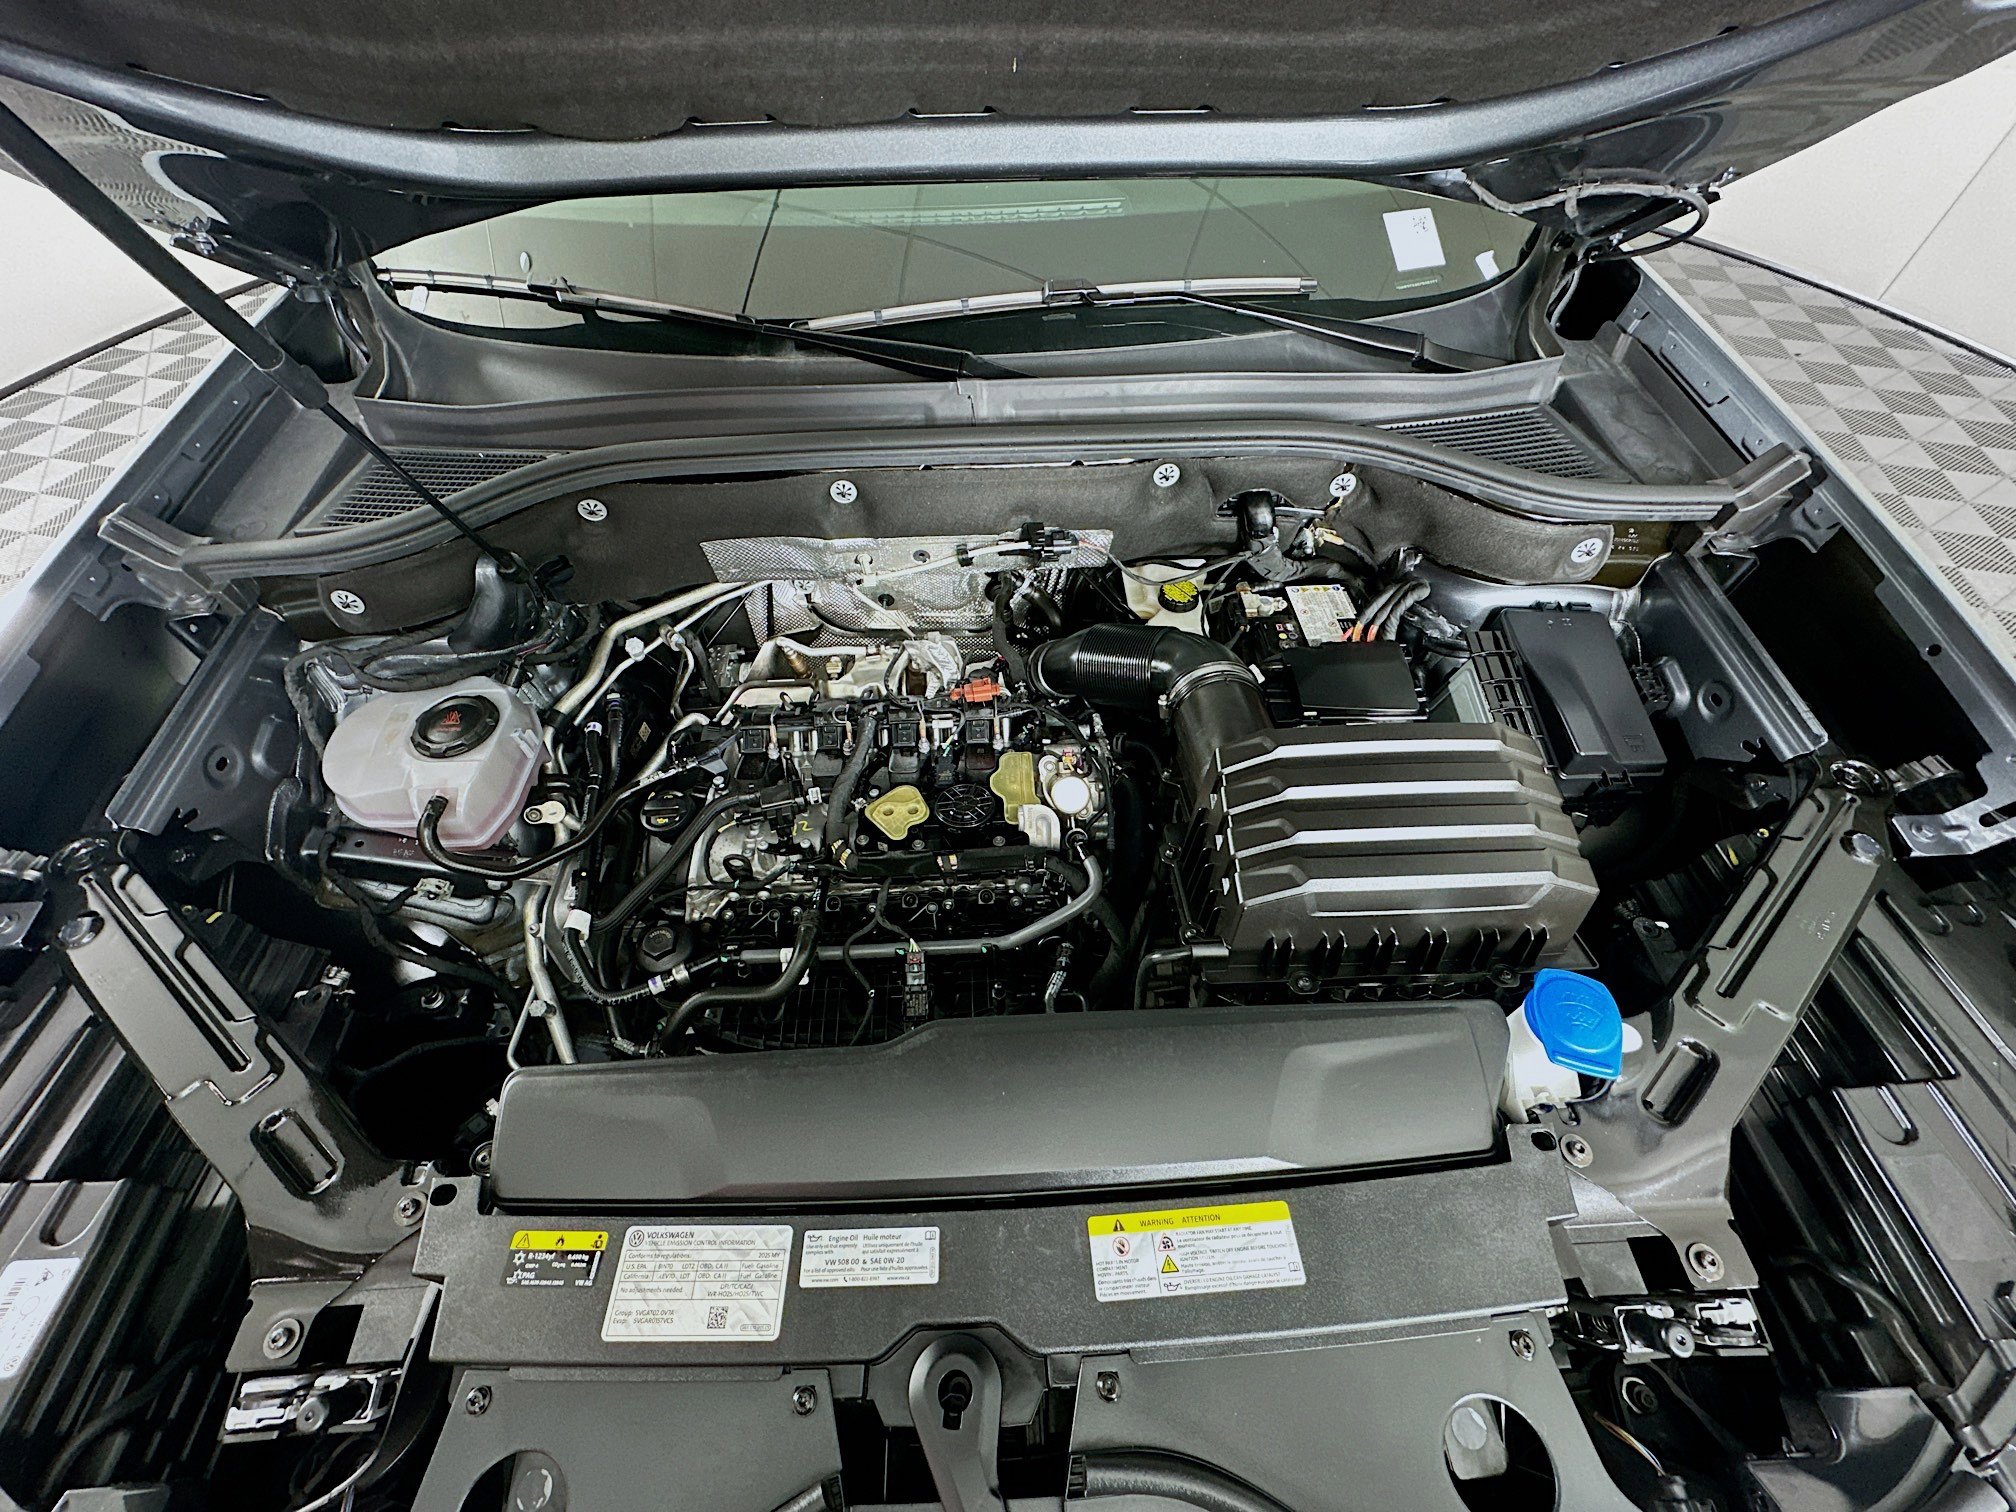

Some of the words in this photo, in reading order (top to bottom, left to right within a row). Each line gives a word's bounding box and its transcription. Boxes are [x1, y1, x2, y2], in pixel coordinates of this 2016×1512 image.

[1139, 1217, 1174, 1227] WARNING
[1181, 1214, 1221, 1224] ATTENTION
[647, 1231, 695, 1239] VOLKSWAGEN
[828, 1235, 849, 1243] Engine
[849, 1234, 859, 1242] Oil
[863, 1233, 879, 1241] Huile
[522, 1271, 536, 1279] PAG
